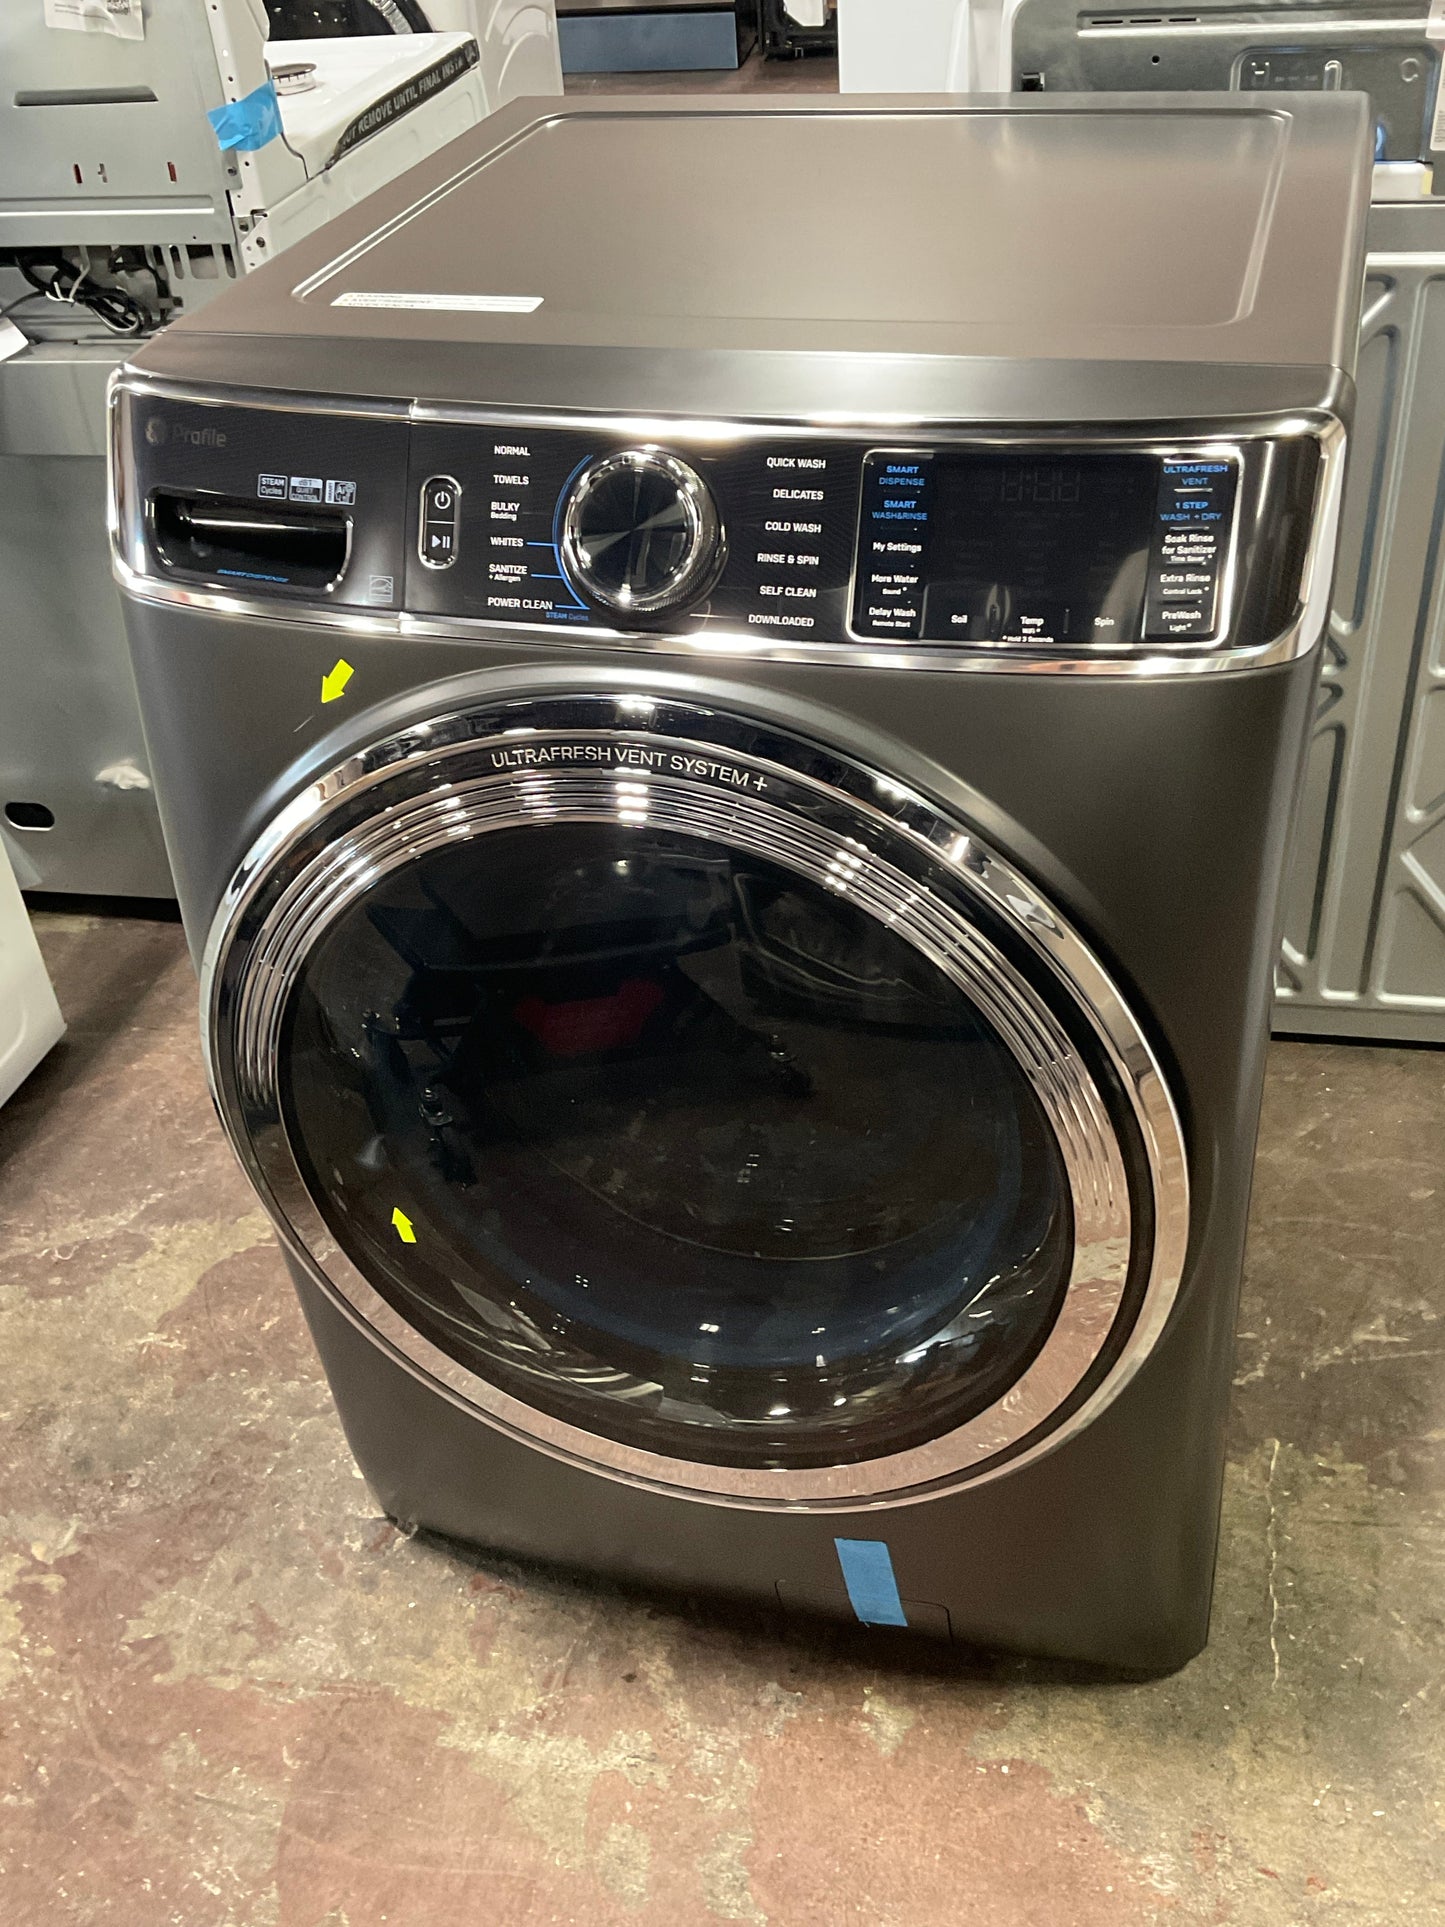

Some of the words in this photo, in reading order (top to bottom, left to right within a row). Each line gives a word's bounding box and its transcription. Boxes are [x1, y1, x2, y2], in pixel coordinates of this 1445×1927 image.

[358, 100, 392, 133] REMOVE
[393, 85, 418, 110] UNTIL
[419, 70, 442, 95] FINAL
[494, 445, 531, 456] NORMAL
[766, 457, 796, 468] QUICK
[797, 458, 827, 469] WASH
[886, 465, 920, 474] SMART
[1163, 465, 1228, 474] ULTRAFRESH
[261, 477, 285, 486] STEAM
[493, 474, 529, 485] TOWELS
[878, 477, 926, 486] DISPENSE
[1181, 477, 1209, 486] VENT
[260, 486, 283, 495] Cycles
[772, 488, 824, 500] DELICATES
[490, 501, 520, 512] BULKY
[883, 500, 917, 509] SMART
[1182, 501, 1209, 509] STEP
[490, 512, 517, 522] Bedding
[871, 511, 928, 521] WASH&RINSE
[1160, 513, 1191, 521] WASH
[1201, 512, 1222, 521] DRY
[765, 521, 791, 532] COLD
[792, 522, 822, 533] WASH
[490, 537, 524, 548] WHITES
[1164, 534, 1187, 544] Soak
[1188, 533, 1215, 543] Rinse
[872, 541, 886, 552] My
[886, 541, 922, 554] Settings
[1161, 545, 1176, 555] for
[1176, 544, 1217, 554] Sanitizer
[757, 553, 785, 564] RINSE
[787, 554, 795, 564] &
[796, 555, 820, 566] SPIN
[489, 563, 528, 575] SANITIZE
[494, 573, 522, 583] Allergen
[871, 574, 892, 583] More
[893, 574, 919, 584] Water
[1160, 573, 1184, 583] Extra
[1185, 573, 1211, 583] Rinse
[759, 586, 784, 597] SELF
[784, 587, 817, 598] CLEAN
[487, 597, 521, 608] POWER
[522, 598, 553, 610] CLEAN
[545, 611, 568, 620] STEAM
[868, 607, 892, 618] Delay
[893, 608, 917, 618] Wash
[1161, 610, 1202, 620] PreWash
[748, 614, 815, 628] DOWNLOADED
[951, 614, 968, 624] Soil
[1020, 616, 1045, 627] Temp
[1094, 616, 1115, 627] Spin
[1169, 624, 1187, 633] Light
[490, 745, 612, 769] ULTRAFRESH
[613, 747, 668, 767] VENT
[670, 754, 750, 788] SYSTEM
